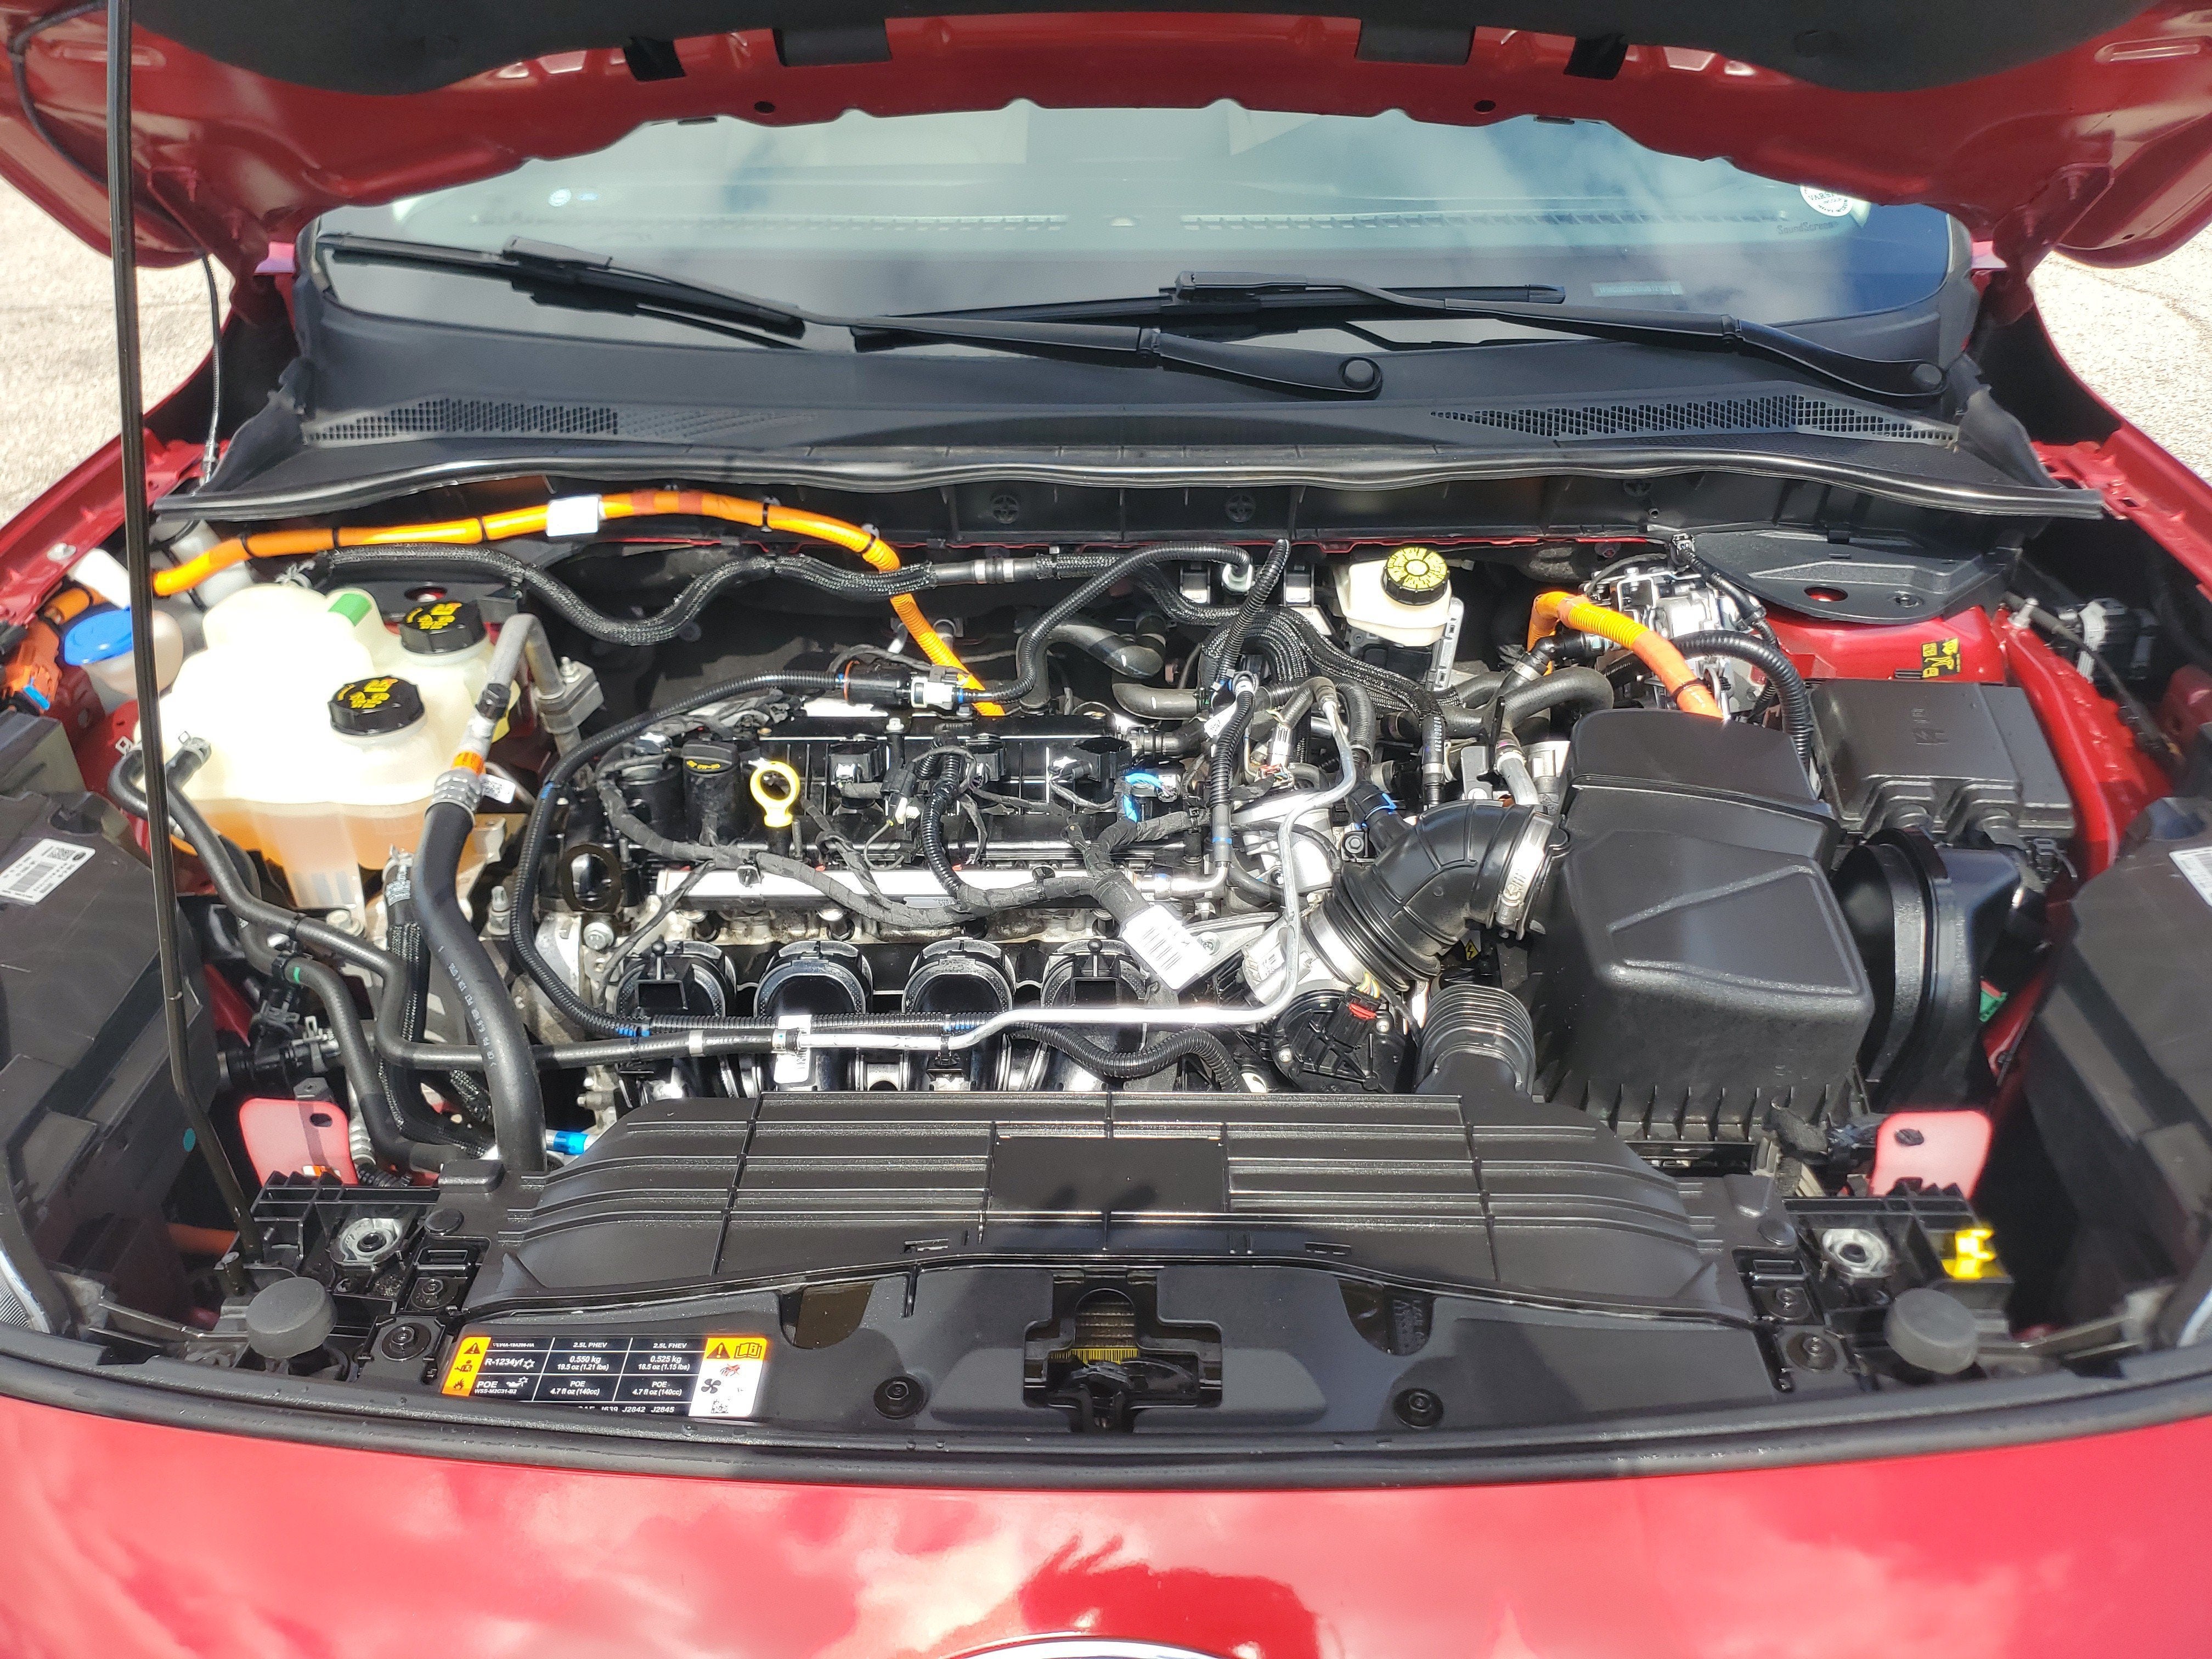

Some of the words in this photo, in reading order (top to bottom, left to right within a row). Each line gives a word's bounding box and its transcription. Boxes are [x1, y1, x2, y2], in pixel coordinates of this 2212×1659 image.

[484, 1358, 524, 1367] R-1234yf
[591, 1356, 602, 1364] kg
[672, 1355, 682, 1364] kg
[576, 1388, 600, 1396] (140cc)
